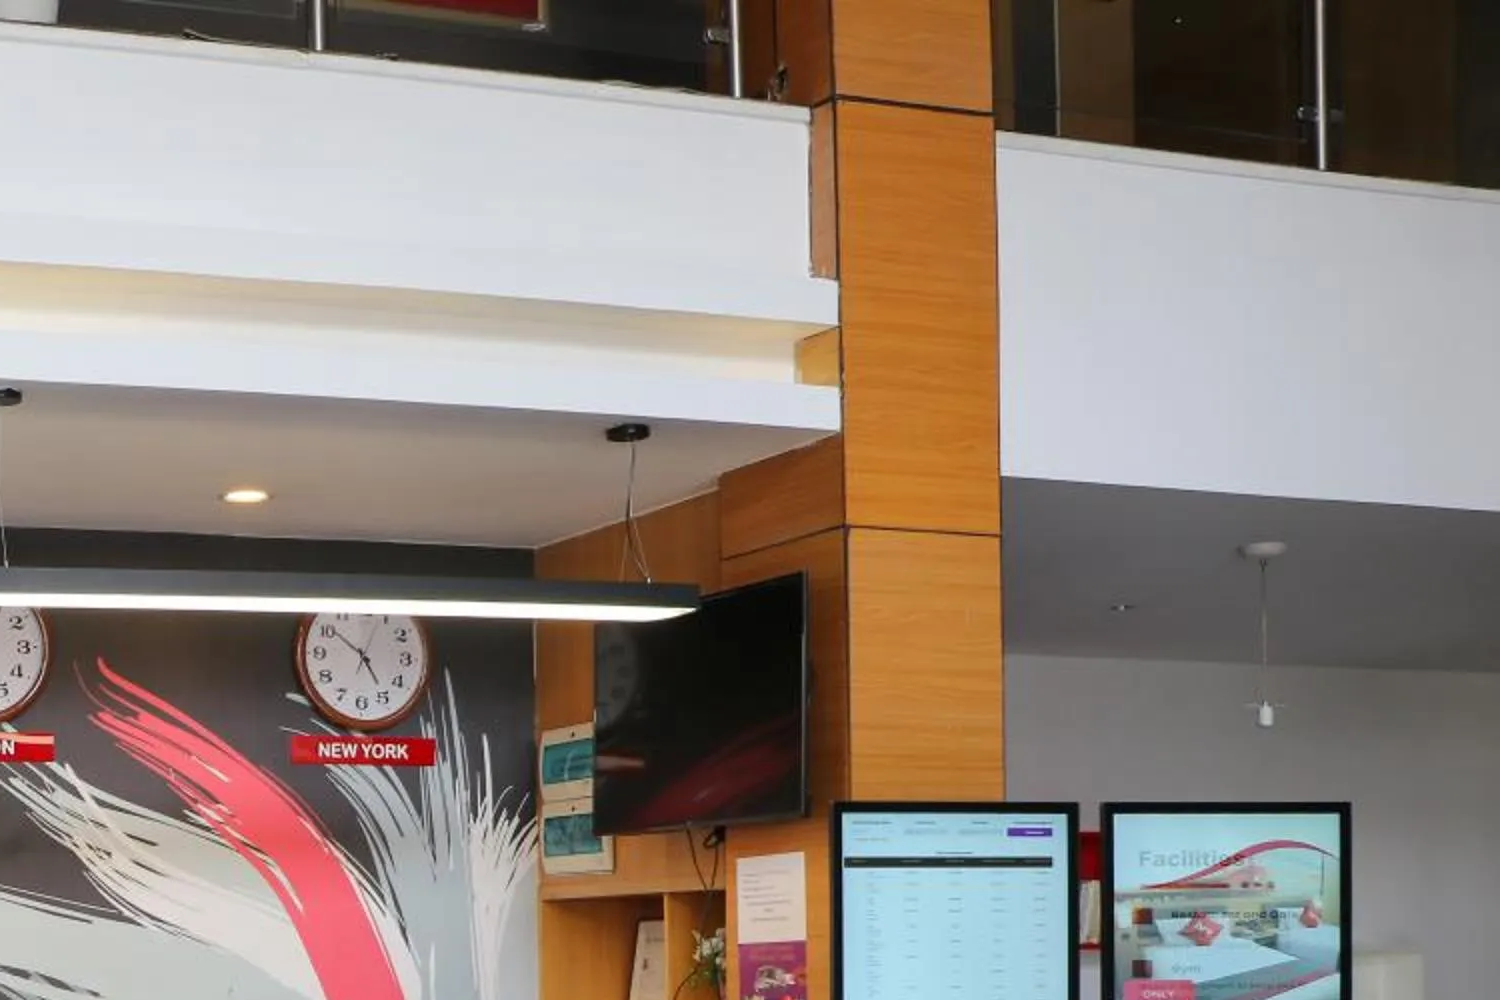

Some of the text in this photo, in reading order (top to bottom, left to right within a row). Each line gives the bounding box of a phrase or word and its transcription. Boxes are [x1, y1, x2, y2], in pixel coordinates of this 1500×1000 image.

[9, 616, 24, 630] 2
[321, 625, 336, 638] 10
[394, 628, 407, 642] 2
[17, 640, 31, 654] 3
[313, 647, 326, 660] 9
[400, 651, 412, 666] 3
[10, 664, 23, 679] 4
[319, 670, 332, 684] 8
[392, 676, 403, 688] 4
[336, 688, 347, 701] 7
[377, 691, 389, 704] 5
[356, 696, 368, 710] 6
[318, 742, 409, 760] NEW YORK
